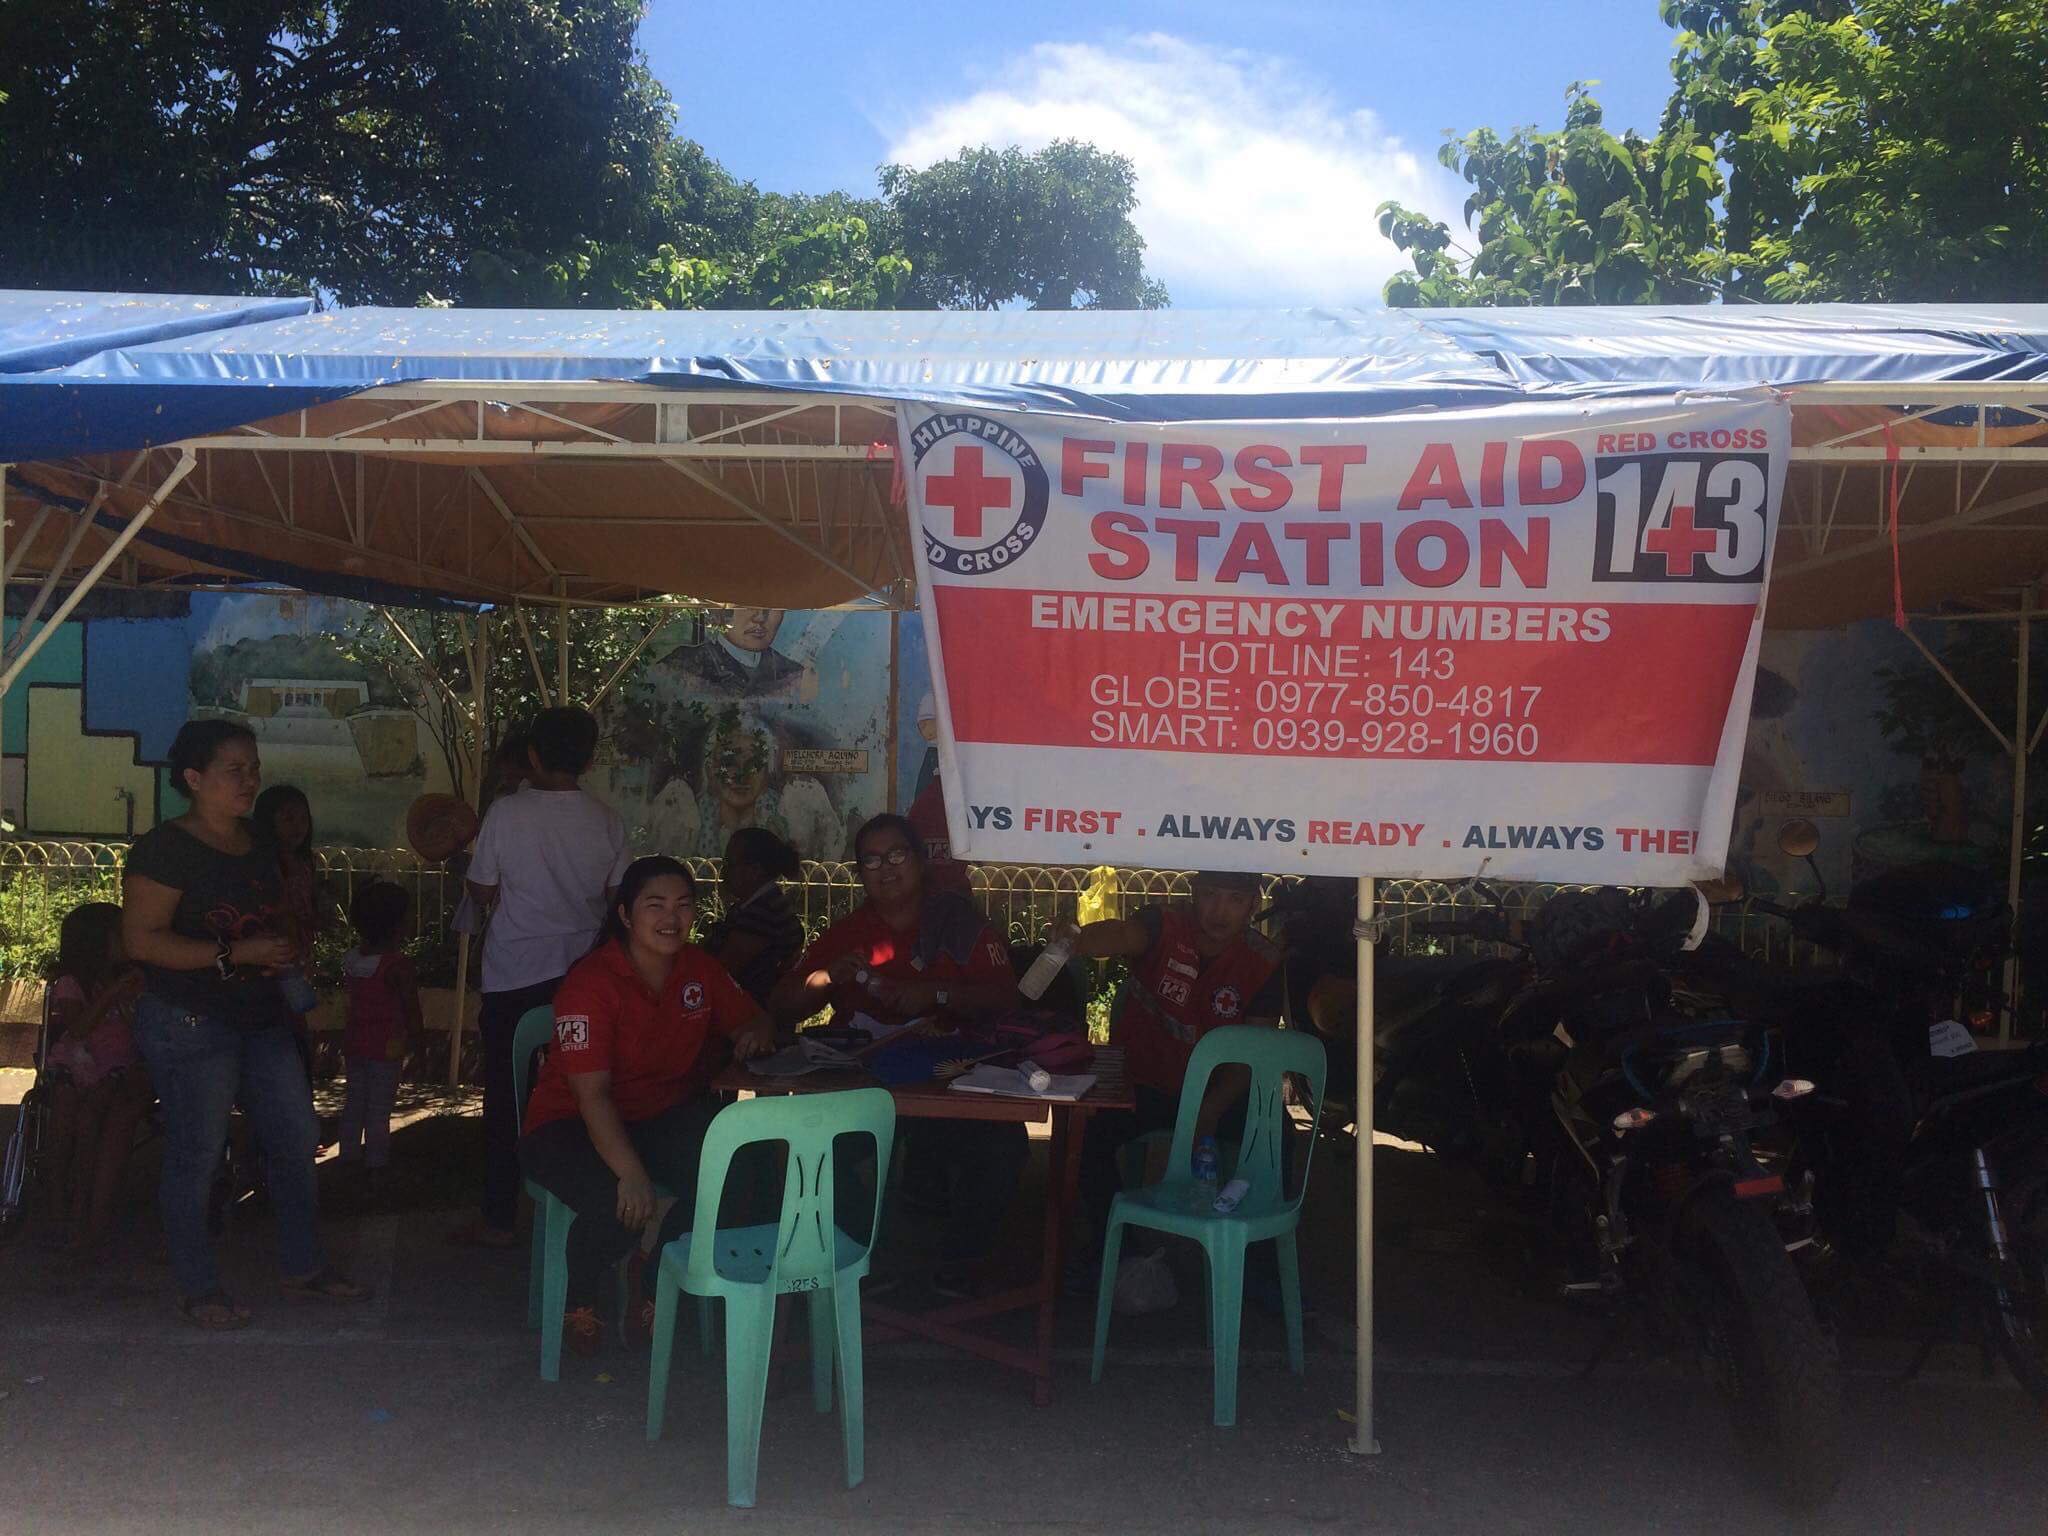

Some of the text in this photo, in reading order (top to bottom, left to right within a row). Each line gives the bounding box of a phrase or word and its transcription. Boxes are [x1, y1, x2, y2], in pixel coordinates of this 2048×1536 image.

[1596, 429, 1768, 454] RED CROSS
[1061, 436, 1586, 512] FIRST AID
[1598, 460, 1766, 577] 143
[957, 526, 1034, 571] CROSS
[1088, 511, 1551, 588] STATION
[1031, 595, 1612, 642] EMERGENCY NUMBERS
[1179, 640, 1455, 680] HOTLINE: 143
[1090, 674, 1543, 718] GLOBE: 0977-850-4817
[1090, 711, 1539, 756] SMART: 0939-928-1960
[967, 806, 1013, 830] YS
[1024, 807, 1122, 834] FIRST
[1157, 814, 1296, 843] ALWAYS
[1308, 820, 1425, 847] READY
[1462, 825, 1604, 851] ALWAYS
[1616, 828, 1699, 855] THE
[1162, 981, 1188, 1004] 143
[557, 1021, 586, 1044] 143
